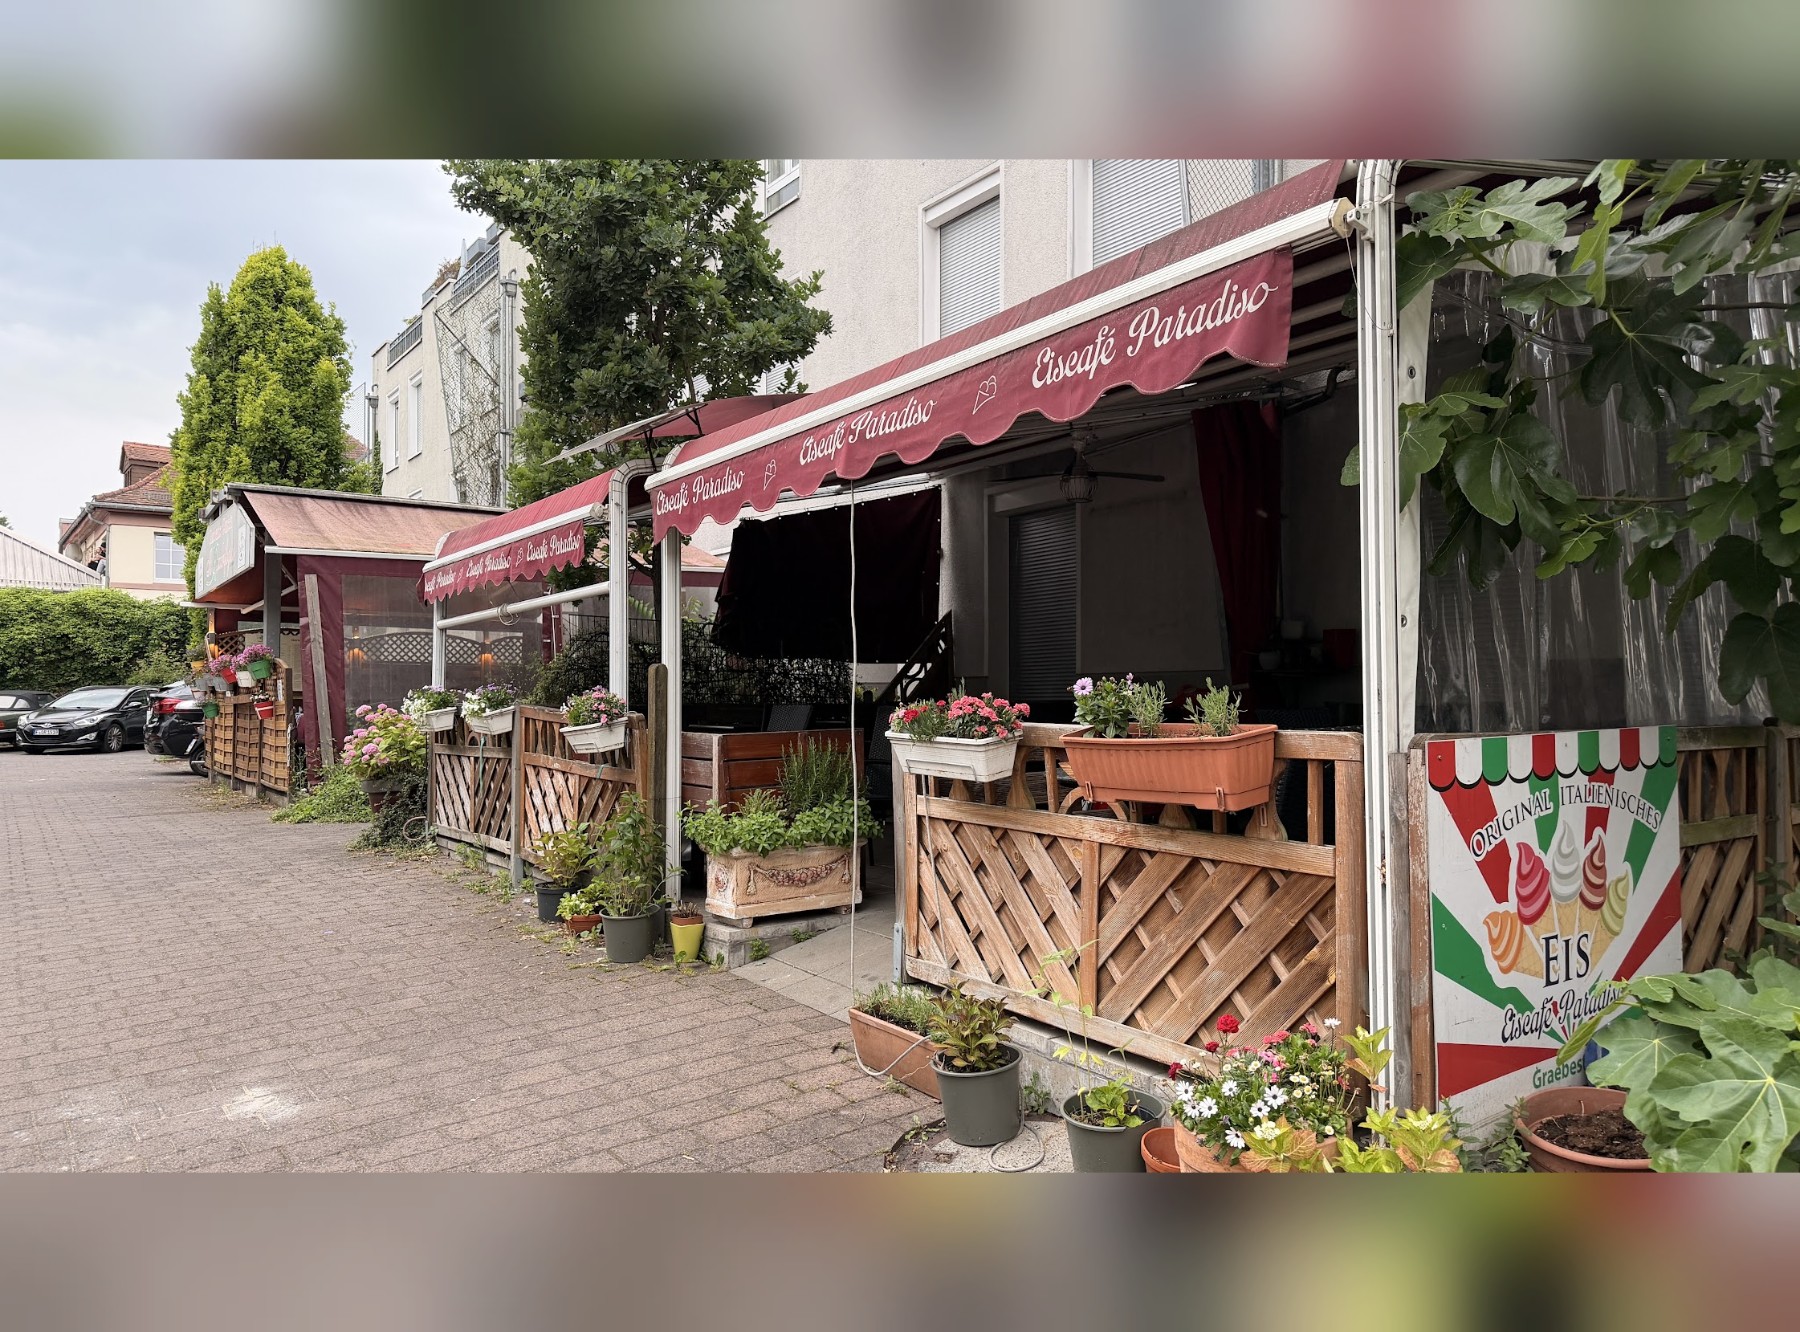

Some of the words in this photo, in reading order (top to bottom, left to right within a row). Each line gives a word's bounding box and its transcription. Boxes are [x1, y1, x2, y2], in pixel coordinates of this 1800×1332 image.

[1031, 325, 1117, 389] Eiscafé
[1126, 279, 1279, 357] Paradiso
[800, 420, 846, 466] Eiscafé
[848, 396, 938, 444] Paradiso
[656, 482, 690, 515] Eiscafé
[692, 466, 746, 504] Paradiso
[526, 538, 549, 563] Eiscafé
[549, 530, 581, 557] Paradiso
[1471, 790, 1553, 858] ORIGINAL
[1559, 784, 1661, 831] ITALIENISCHES
[1542, 932, 1590, 989] EIS
[1501, 995, 1554, 1044] Eiscafé
[1558, 980, 1622, 1025] Paradis
